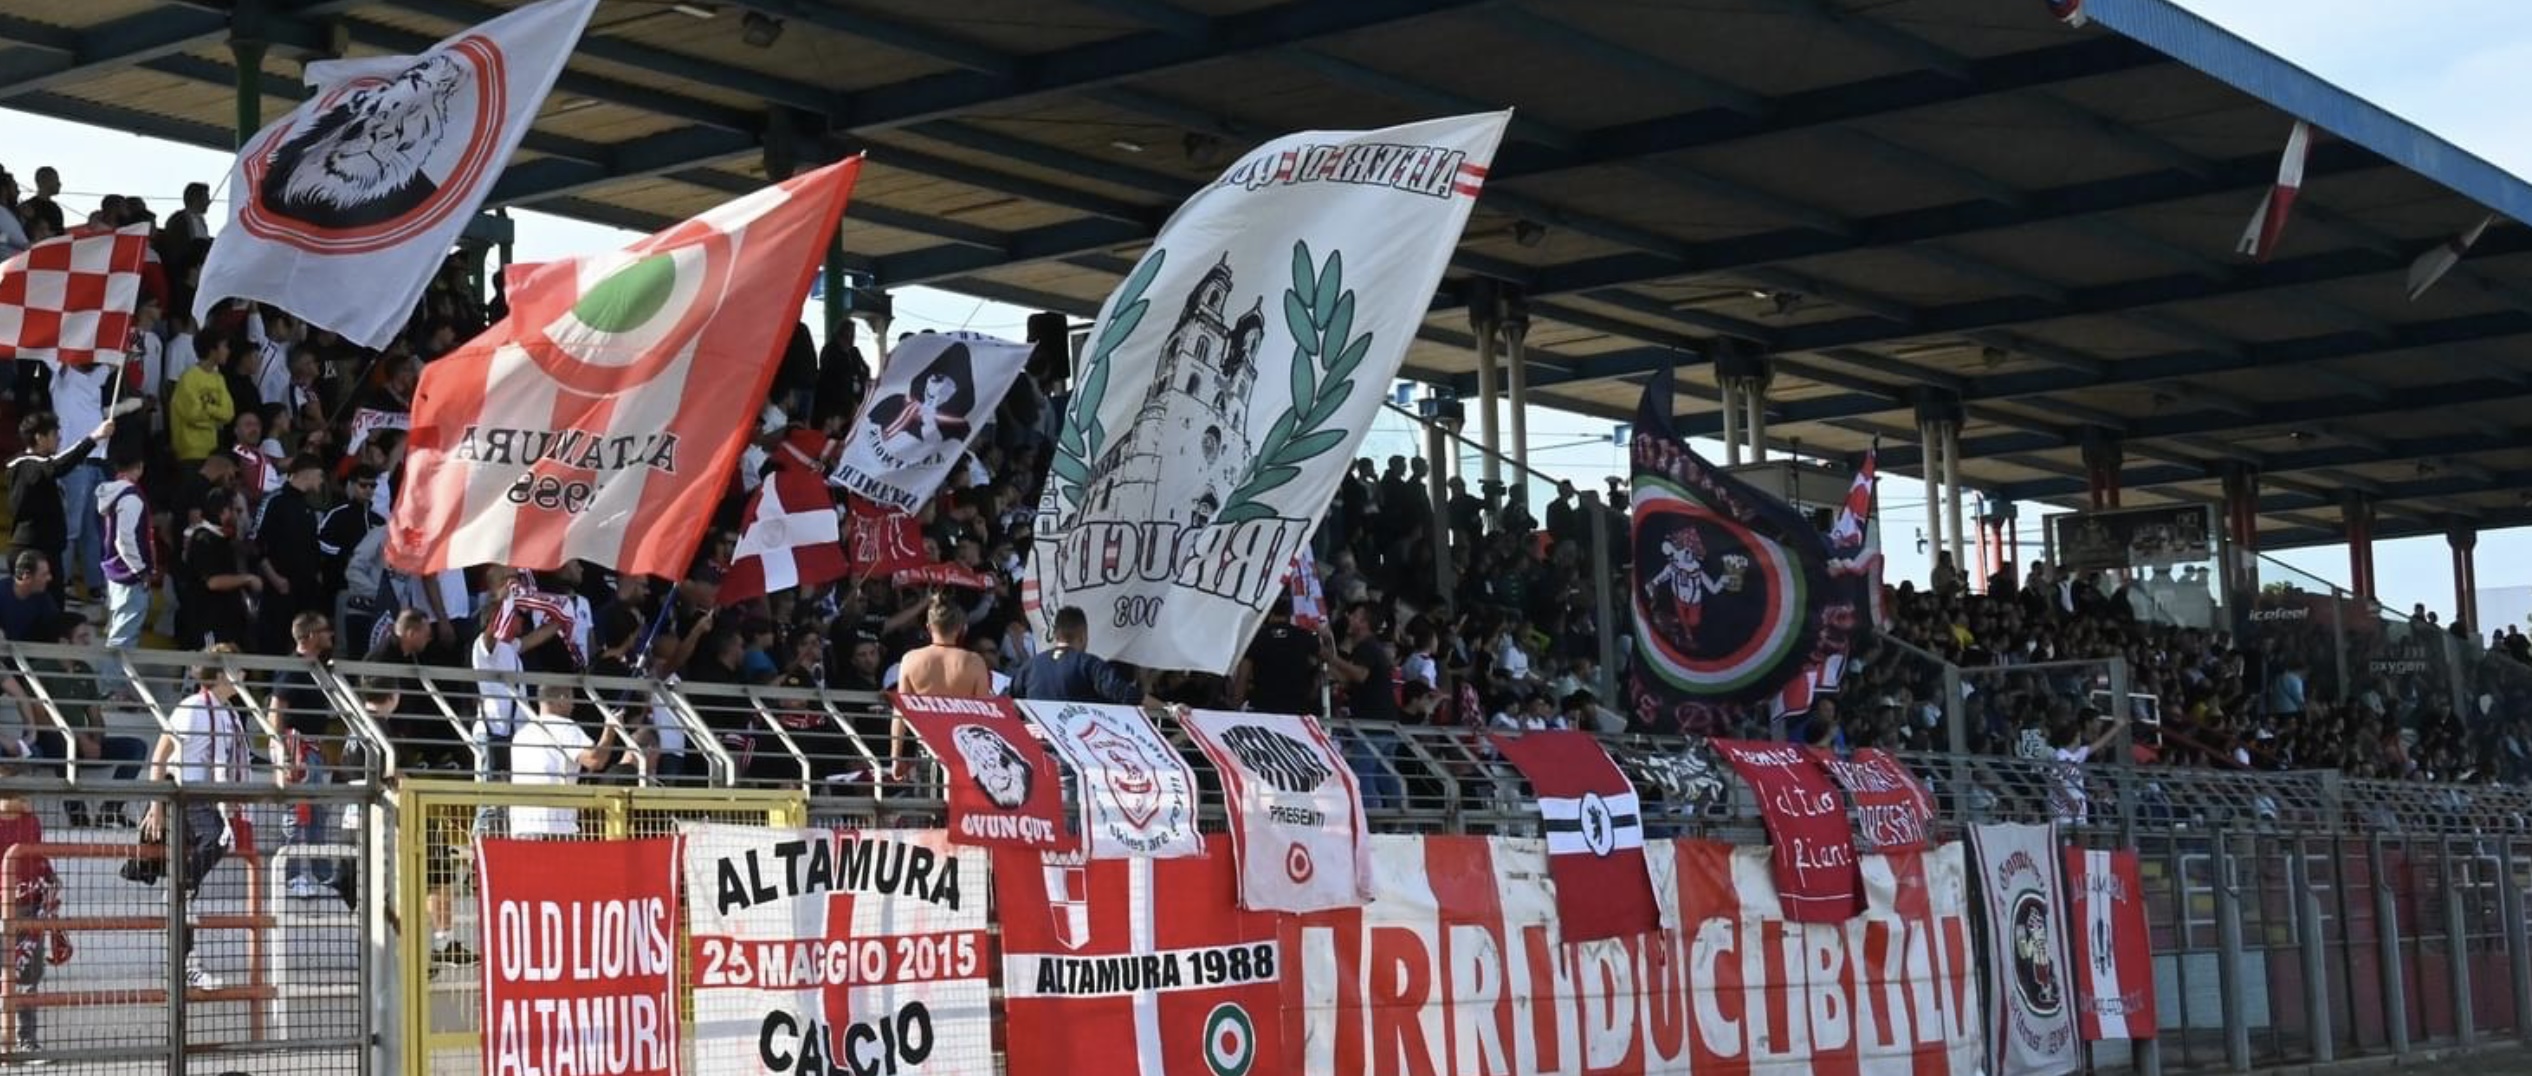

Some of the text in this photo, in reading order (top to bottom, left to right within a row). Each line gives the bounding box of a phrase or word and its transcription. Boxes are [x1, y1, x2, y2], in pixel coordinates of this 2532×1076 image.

[900, 694, 1006, 718] ALTAMURA
[961, 813, 1055, 843] OVUNQUE
[1269, 805, 1326, 828] PRESENTI
[718, 838, 961, 916] ALTAMURA
[499, 897, 668, 981] OLD LIONS
[757, 940, 887, 987] MAGGIO
[896, 933, 977, 980] 2015
[1036, 944, 1274, 994] ALTAMURA 1988
[1301, 915, 1967, 1076] IRRIDUCIBILI
[759, 1000, 934, 1076] CALCIO
